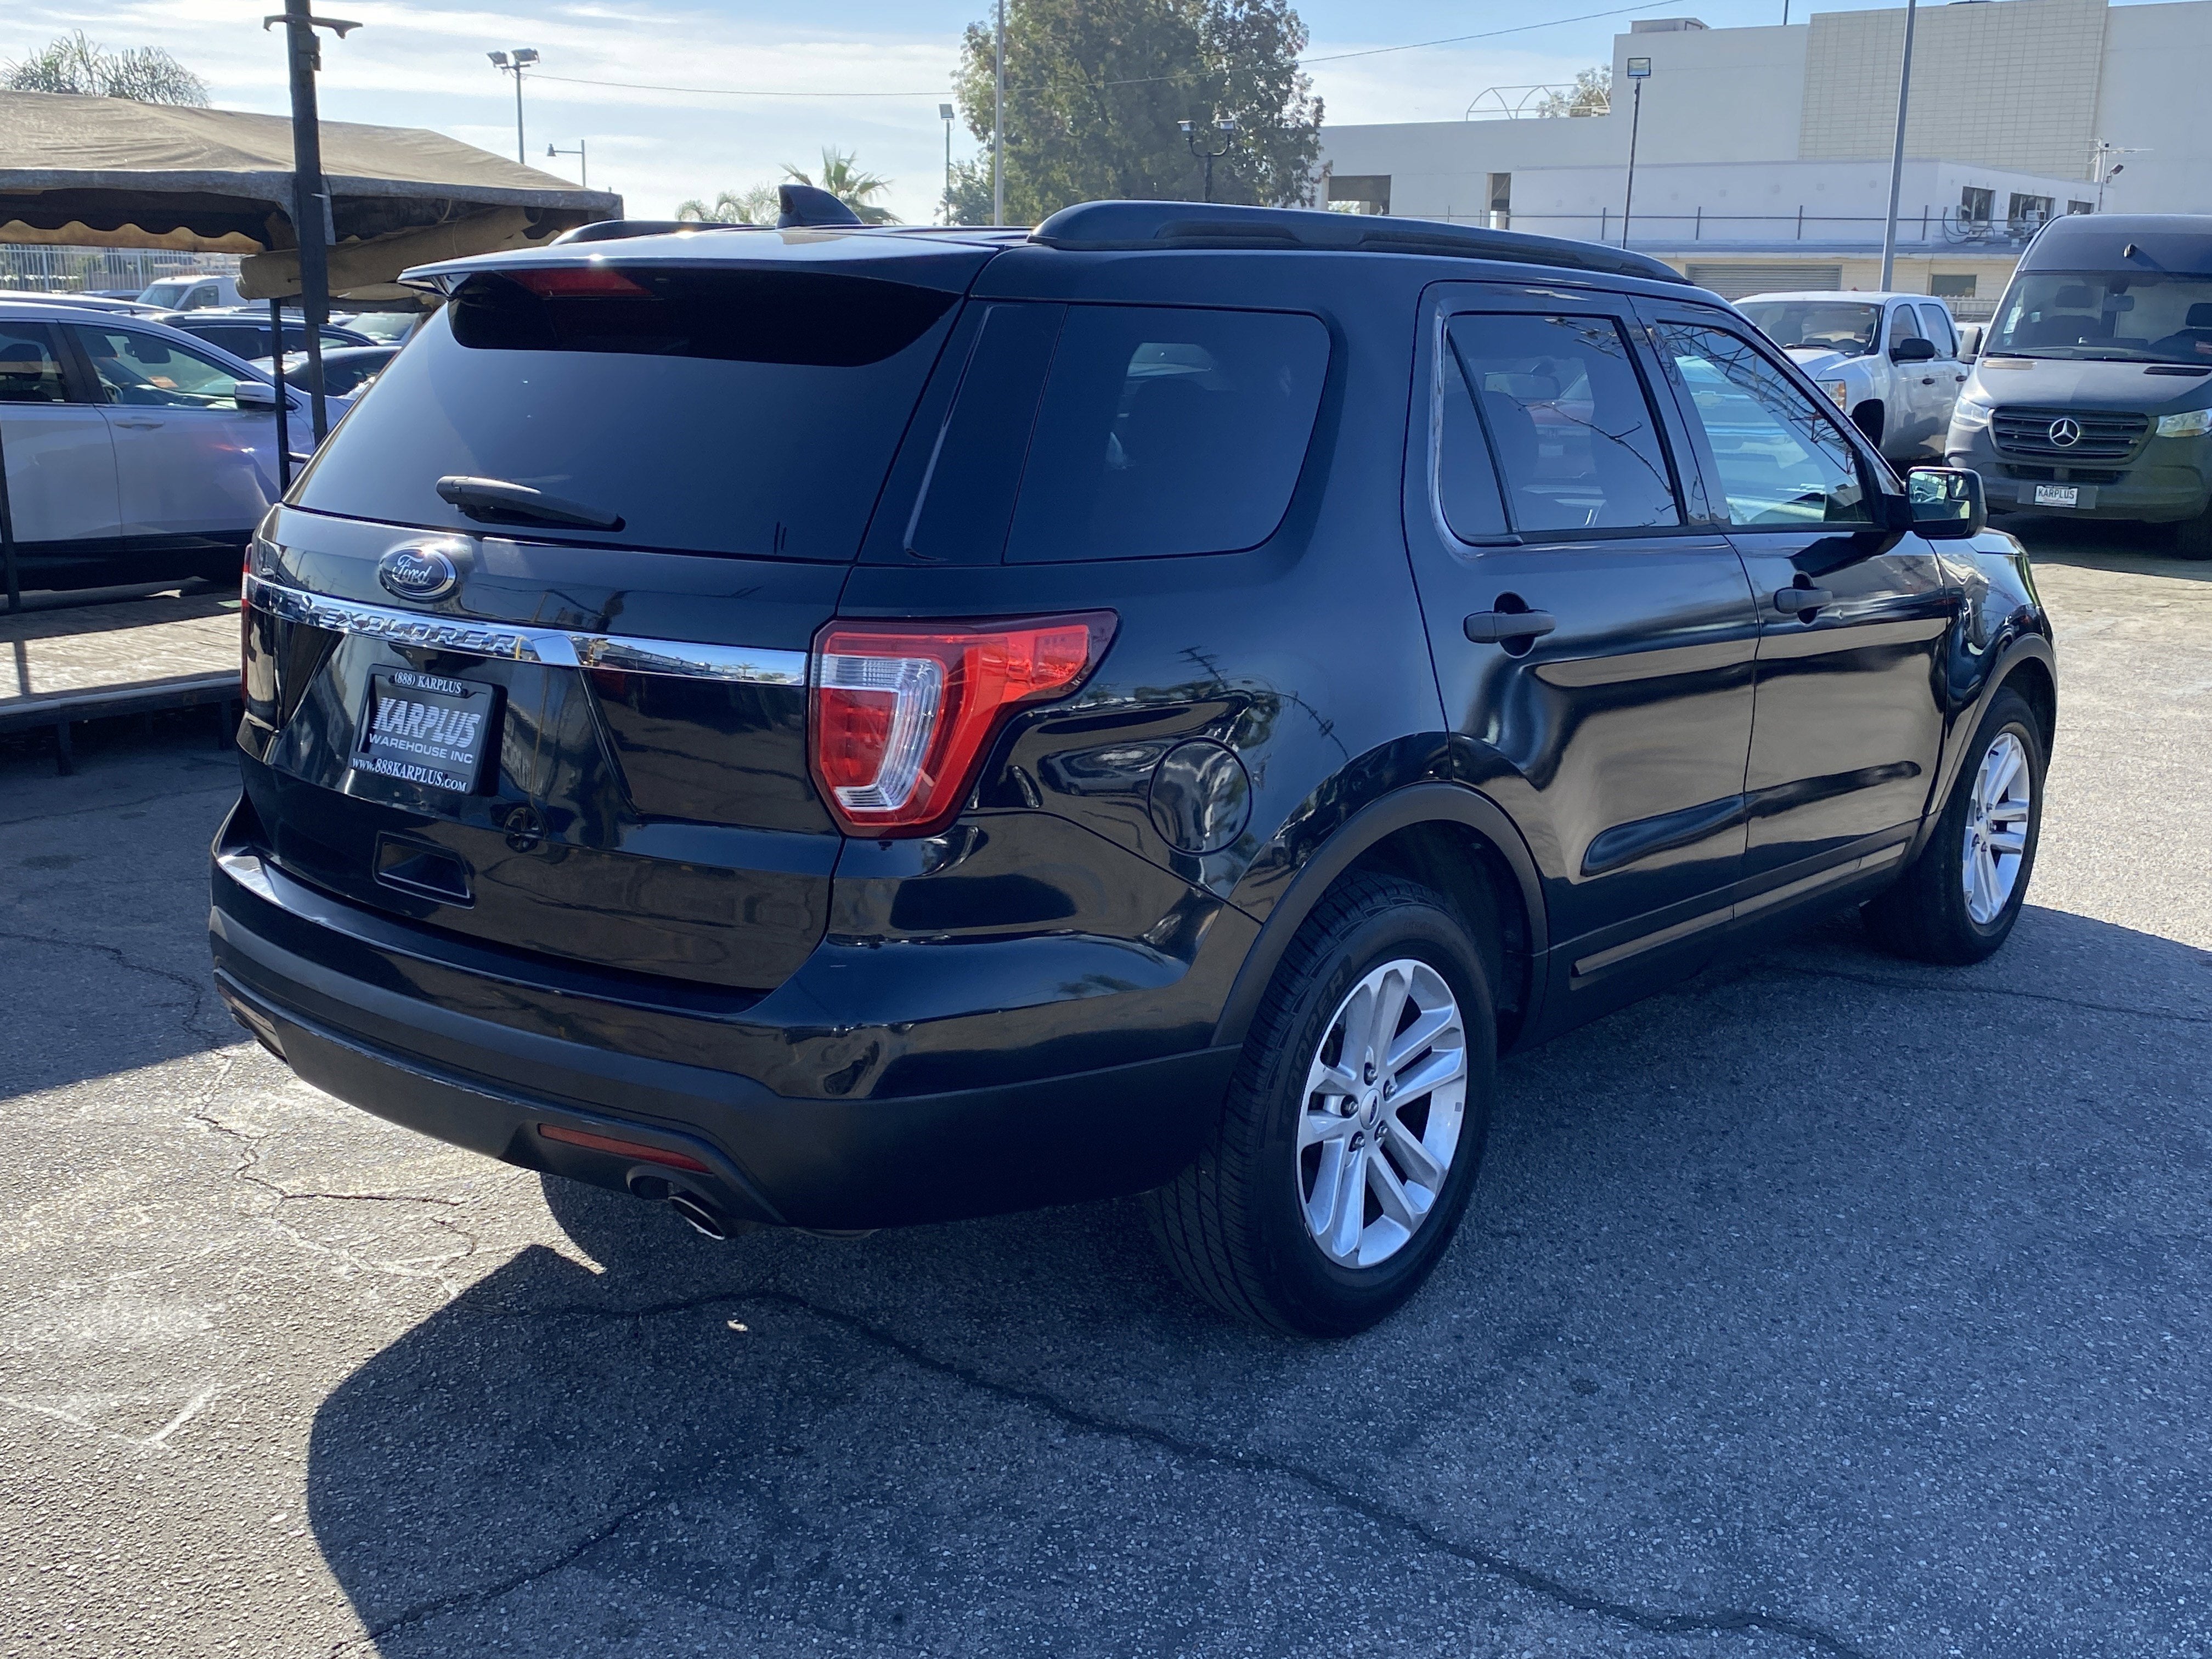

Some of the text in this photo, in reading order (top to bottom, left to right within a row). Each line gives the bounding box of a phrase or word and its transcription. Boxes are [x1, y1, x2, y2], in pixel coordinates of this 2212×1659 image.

[2038, 488, 2075, 499] KARPLUS
[392, 554, 432, 585] Ford
[319, 608, 517, 653] EXPLORER
[394, 672, 462, 694] (888) KARPLUS
[371, 697, 481, 748] KARPLUS
[369, 733, 473, 764] WAREHOUSE INC
